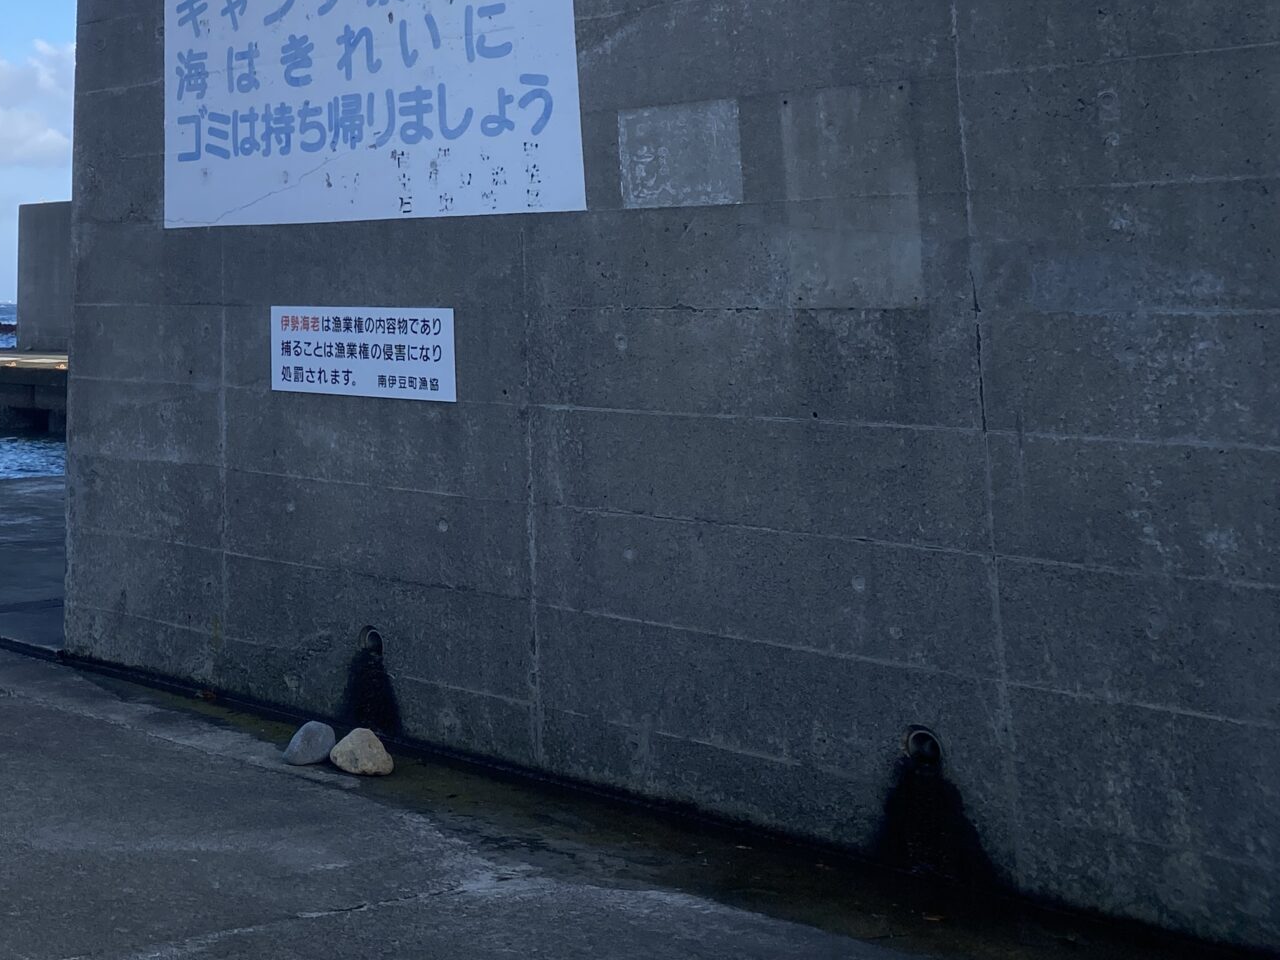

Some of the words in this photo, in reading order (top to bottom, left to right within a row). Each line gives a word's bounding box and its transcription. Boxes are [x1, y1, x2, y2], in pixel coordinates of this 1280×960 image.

[175, 2, 513, 102] 海はきれいに
[177, 73, 554, 163] ゴミは持ち帰りましょう
[280, 314, 442, 336] 伊勢海老は漁業権の内容物であり
[280, 340, 442, 363] 捕ることは漁業権の侵害になり
[281, 365, 357, 386] 処罰されます。
[377, 374, 440, 392] 南伊豆町漁協
